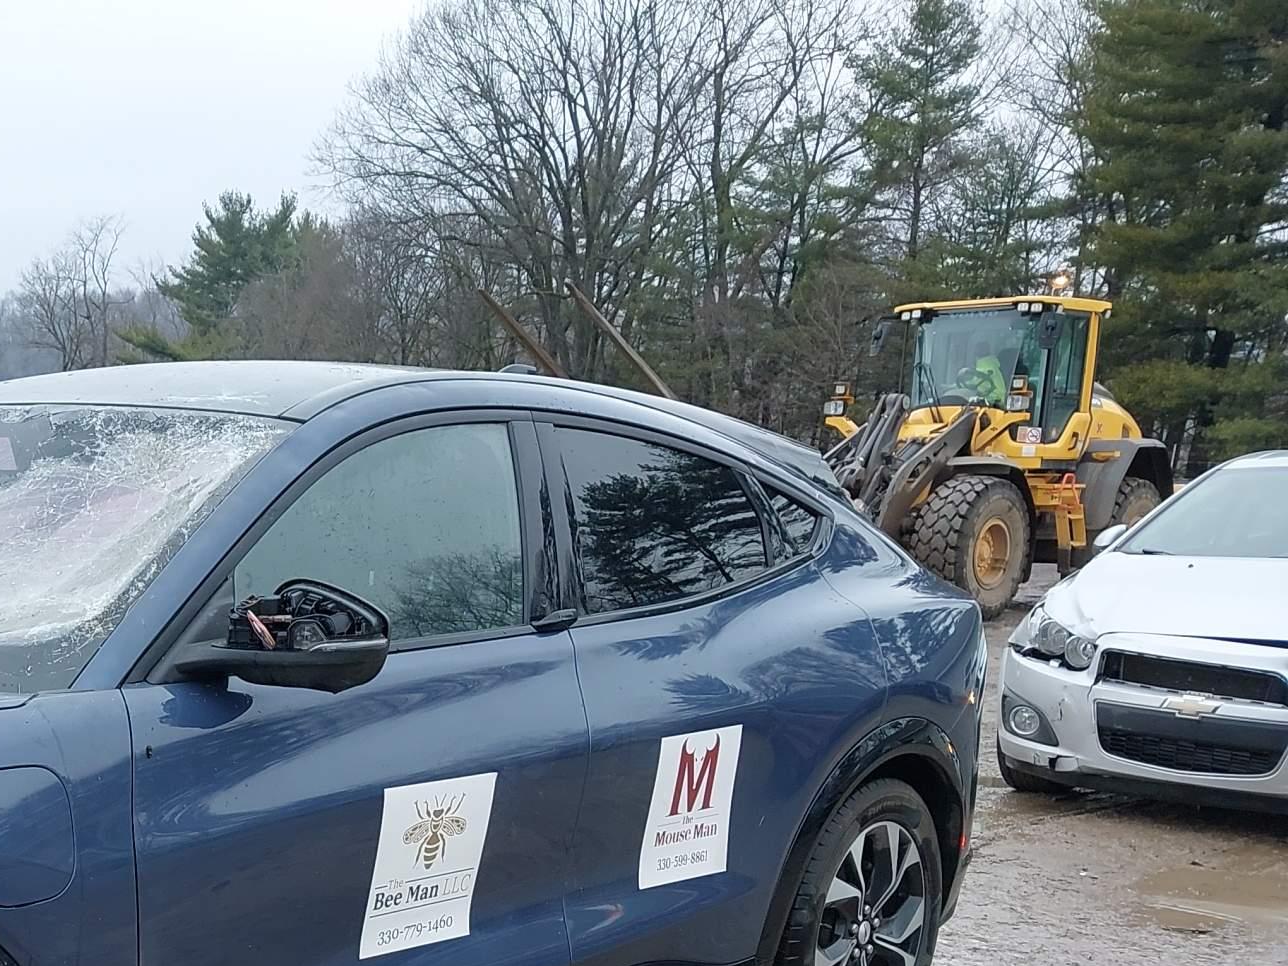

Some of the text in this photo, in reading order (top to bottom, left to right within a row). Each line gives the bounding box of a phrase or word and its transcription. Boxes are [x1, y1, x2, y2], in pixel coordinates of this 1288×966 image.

[654, 823, 717, 847] Mouse Man
[373, 874, 471, 911] Bee Man LLC
[388, 879, 404, 892] The
[377, 914, 453, 946] 330-779-1460
